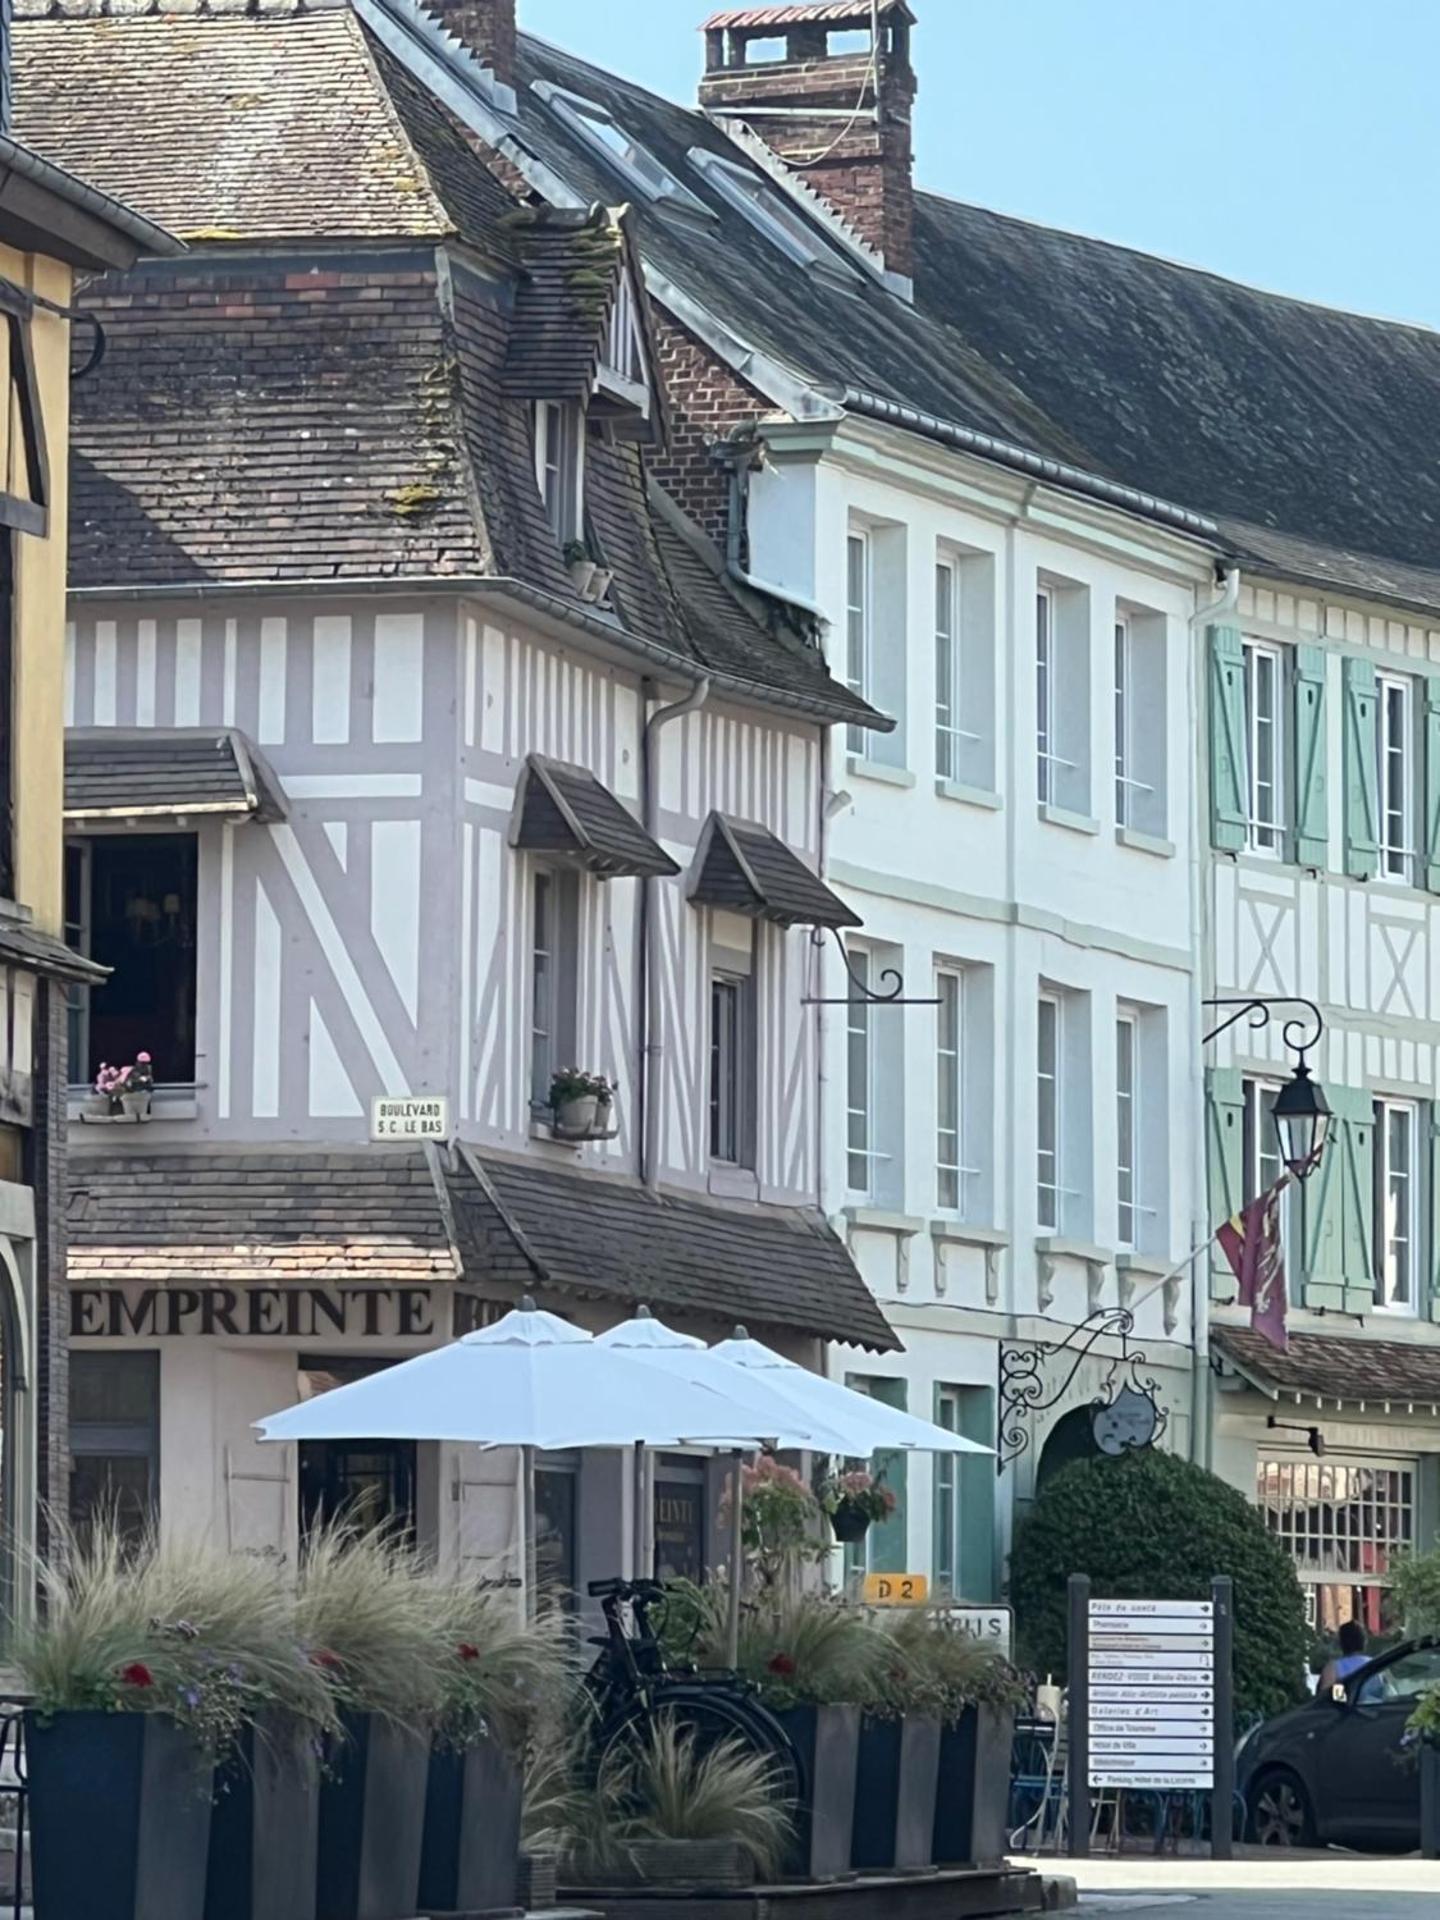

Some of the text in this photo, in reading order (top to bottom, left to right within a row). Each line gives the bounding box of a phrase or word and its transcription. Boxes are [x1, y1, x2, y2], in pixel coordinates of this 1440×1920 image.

[380, 1103, 440, 1117] BOULEVARD
[405, 1120, 417, 1133] LE
[421, 1120, 442, 1133] BAS
[69, 1288, 434, 1336] EMPREINTE
[878, 1580, 913, 1599] D 2
